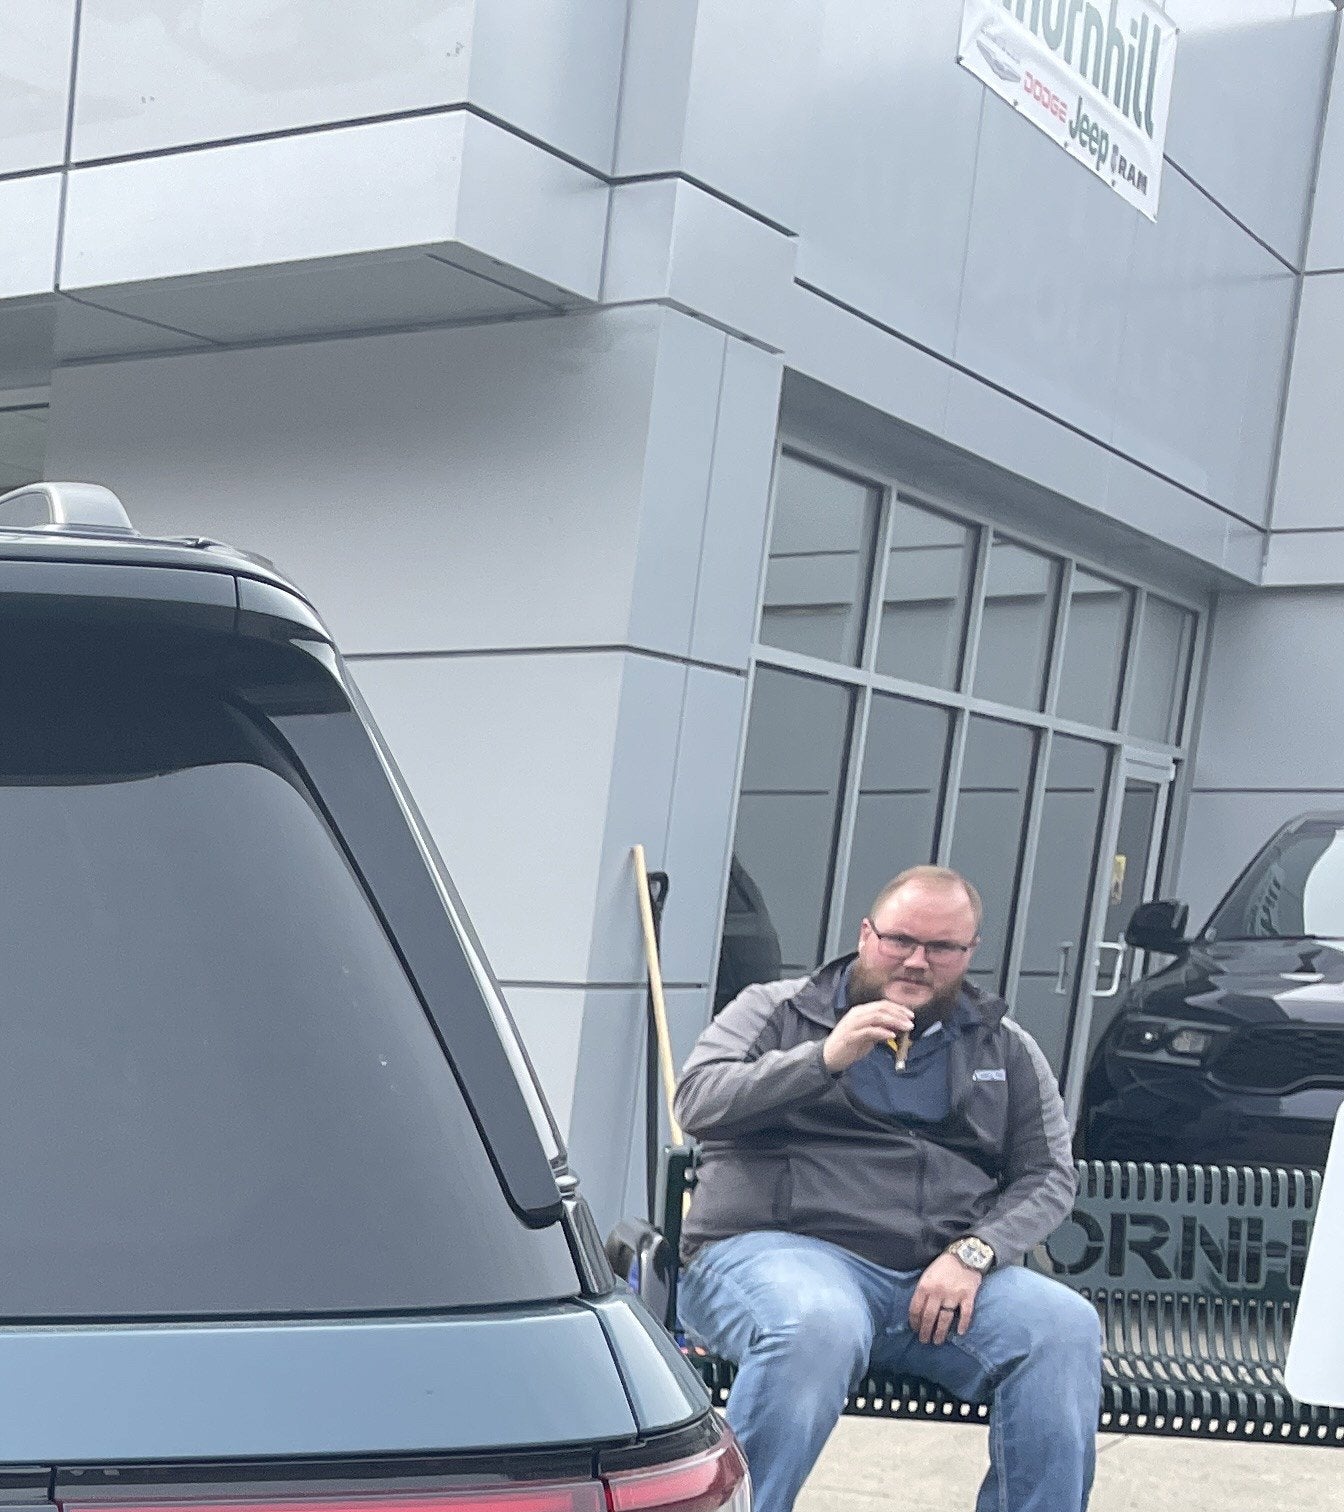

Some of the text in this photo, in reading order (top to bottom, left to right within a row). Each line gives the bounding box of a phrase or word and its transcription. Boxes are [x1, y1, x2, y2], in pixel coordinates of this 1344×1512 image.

[1023, 70, 1148, 196] DODGE Jeep RAM
[1042, 1209, 1309, 1287] ORNH
